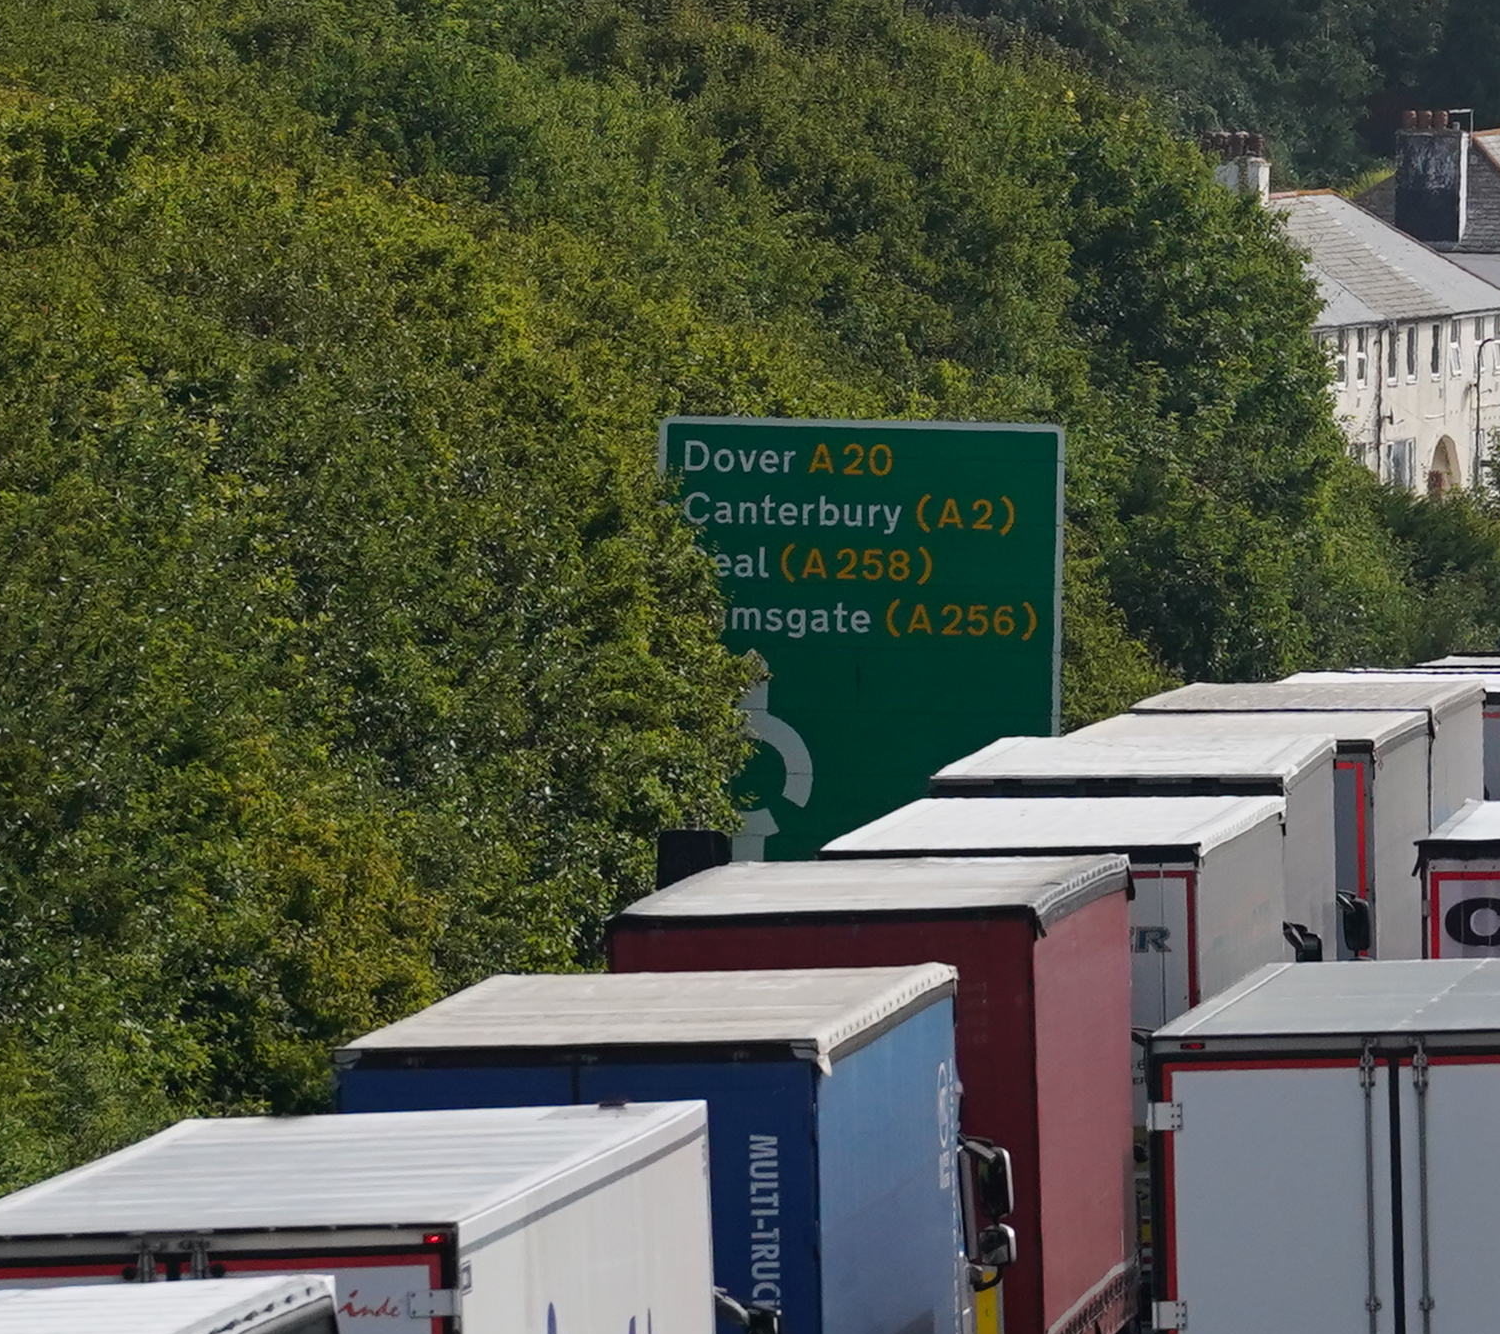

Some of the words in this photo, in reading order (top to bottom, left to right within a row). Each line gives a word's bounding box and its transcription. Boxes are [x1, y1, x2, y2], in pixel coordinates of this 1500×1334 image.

[684, 440, 796, 473] Dover
[809, 444, 893, 477] A20
[683, 492, 901, 534] Canterbury
[694, 545, 769, 578] eal
[781, 544, 933, 586] (A258)
[726, 602, 871, 638] msgate
[887, 600, 1037, 640] (A256)
[749, 1135, 781, 1312] MULTI-TRUC
